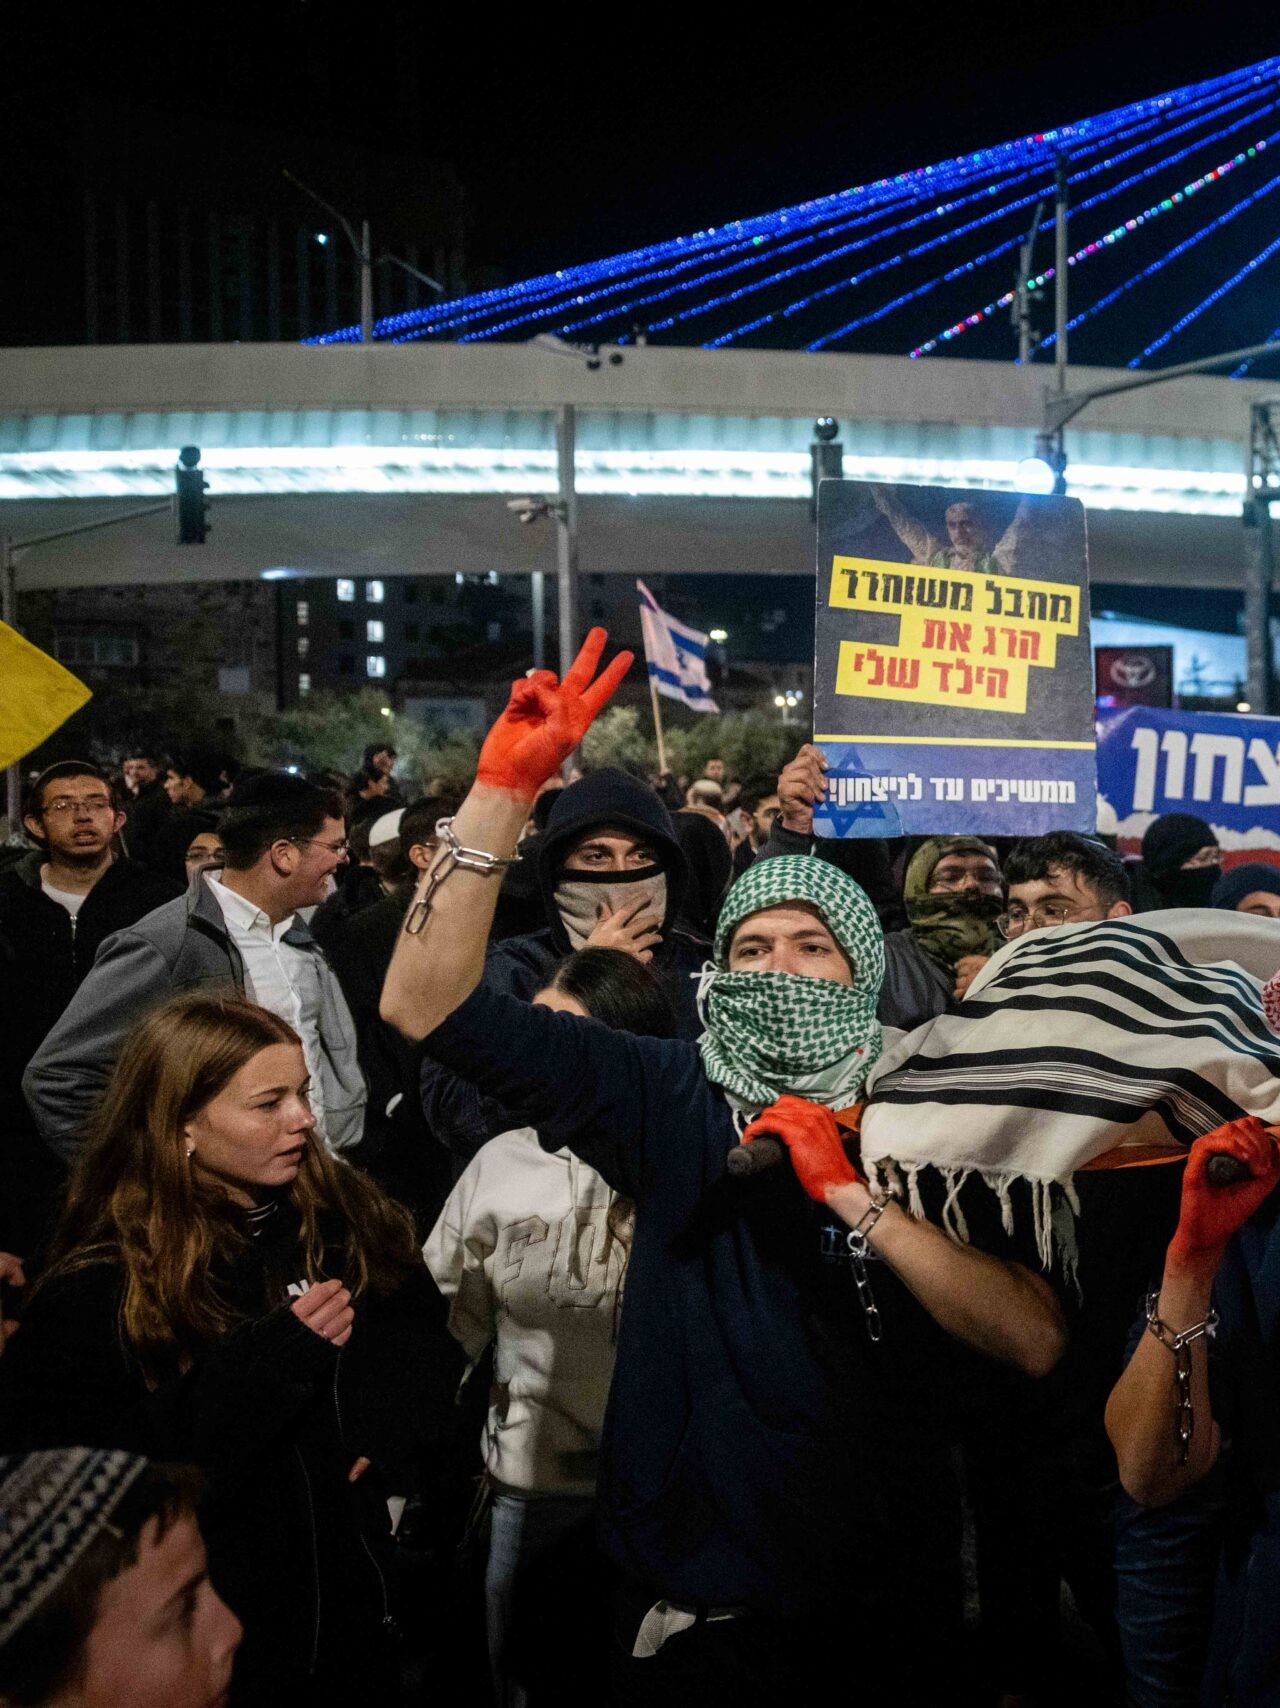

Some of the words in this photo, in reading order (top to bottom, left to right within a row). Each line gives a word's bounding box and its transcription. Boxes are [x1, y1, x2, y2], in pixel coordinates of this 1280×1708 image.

[840, 568, 973, 613] משוחרר
[985, 580, 1072, 624] מחבל
[922, 618, 972, 653] את
[982, 625, 1041, 661] הרג
[853, 648, 920, 690] שלי
[932, 658, 1009, 699] הילד
[929, 777, 964, 801] עד
[971, 777, 1076, 804] ממשיכים
